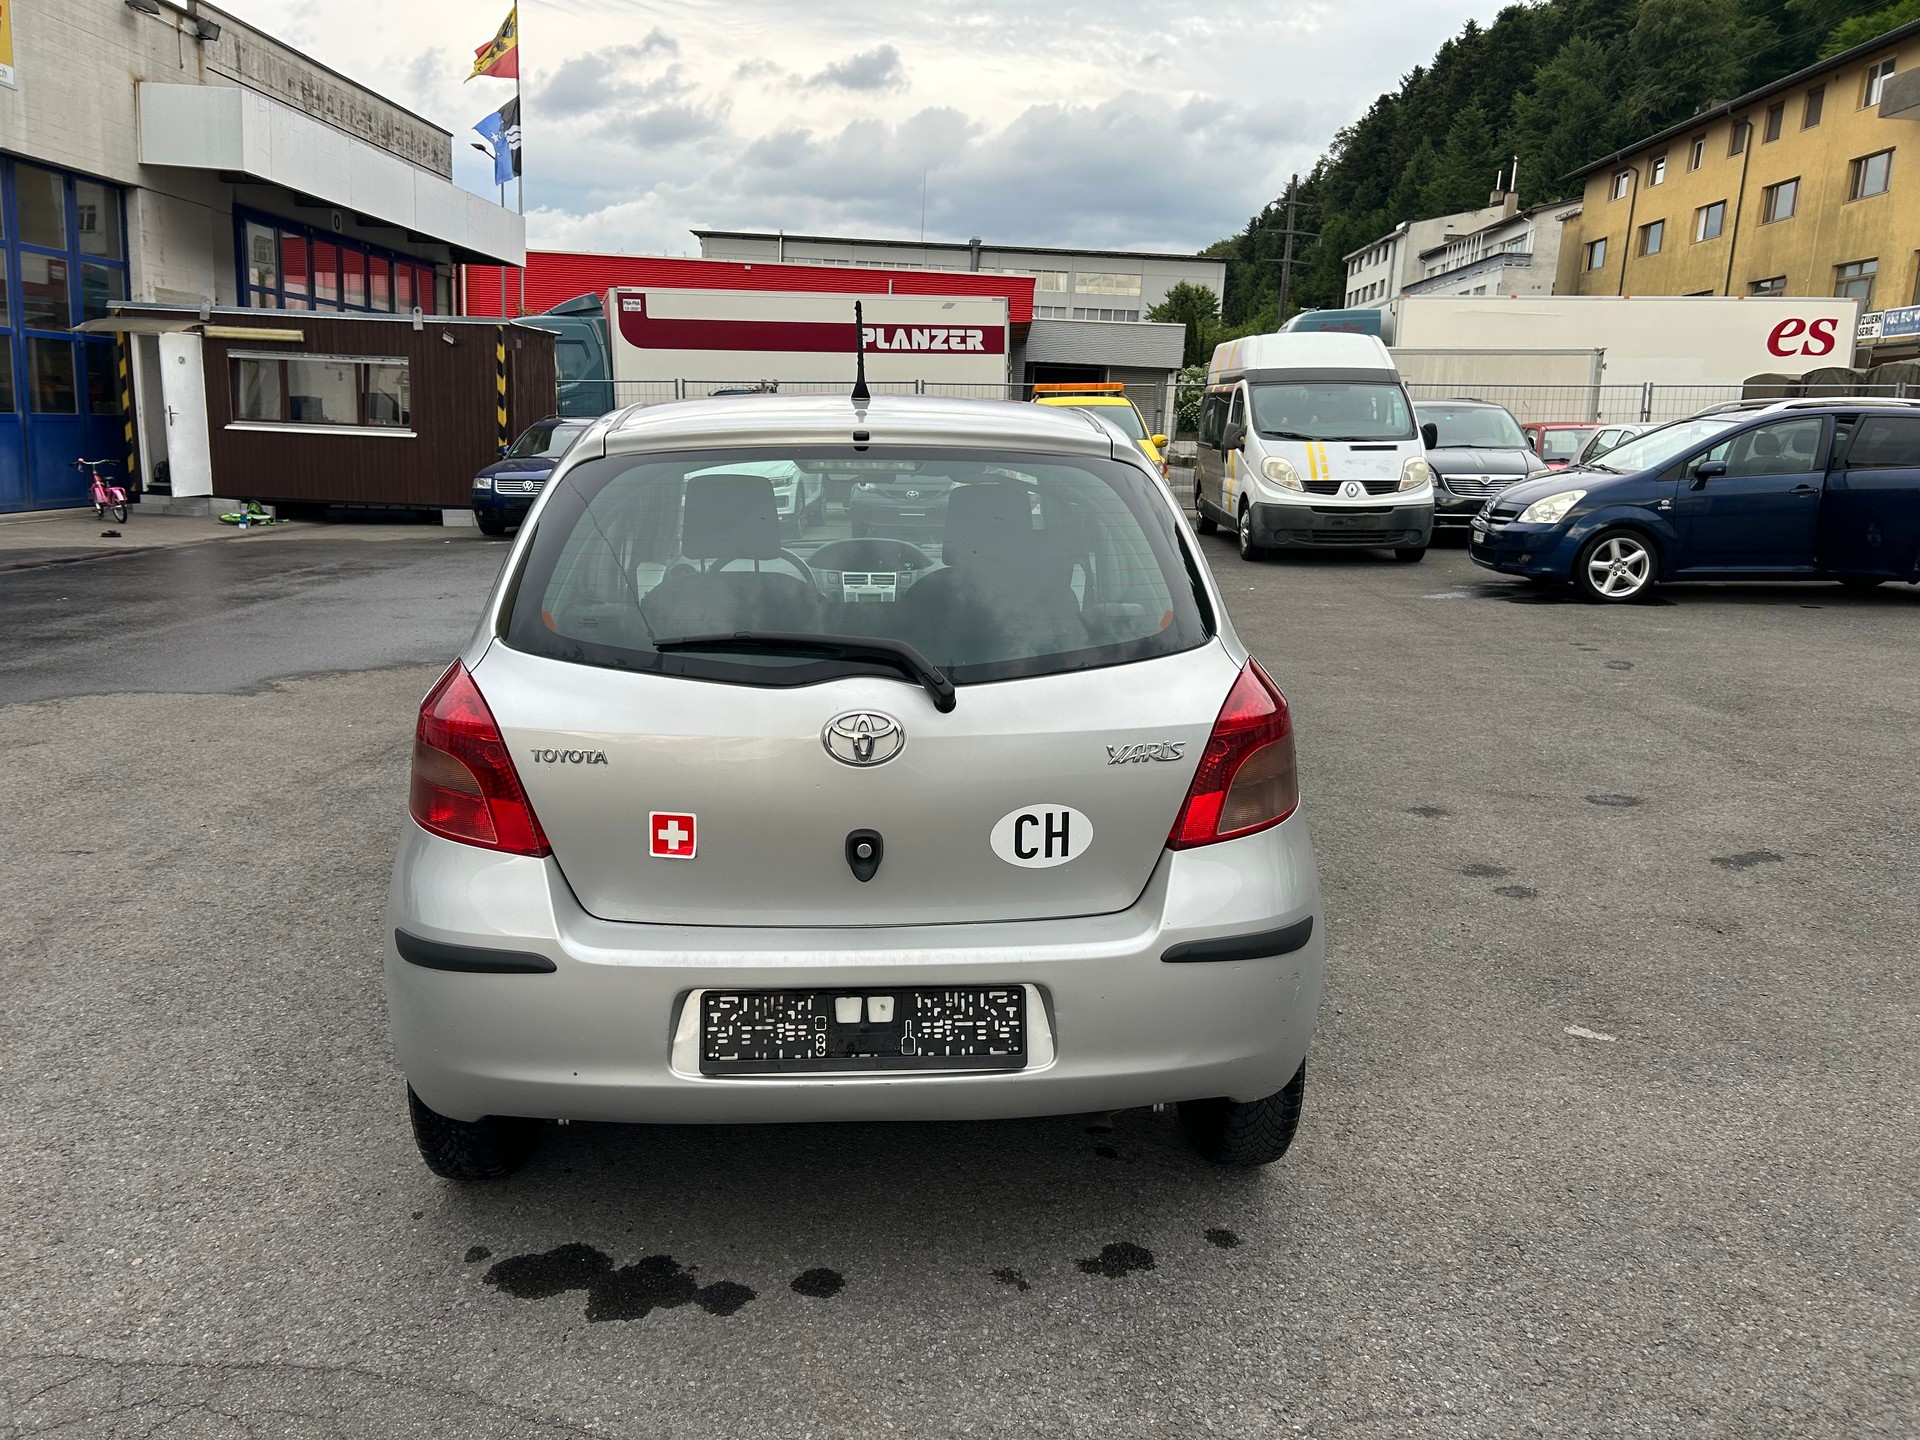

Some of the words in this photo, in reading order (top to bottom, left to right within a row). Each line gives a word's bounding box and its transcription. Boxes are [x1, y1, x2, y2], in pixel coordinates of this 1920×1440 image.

[862, 327, 985, 350] PLANZER
[1766, 318, 1839, 357] es
[530, 748, 608, 765] TOYOTA
[1014, 811, 1070, 860] CH
